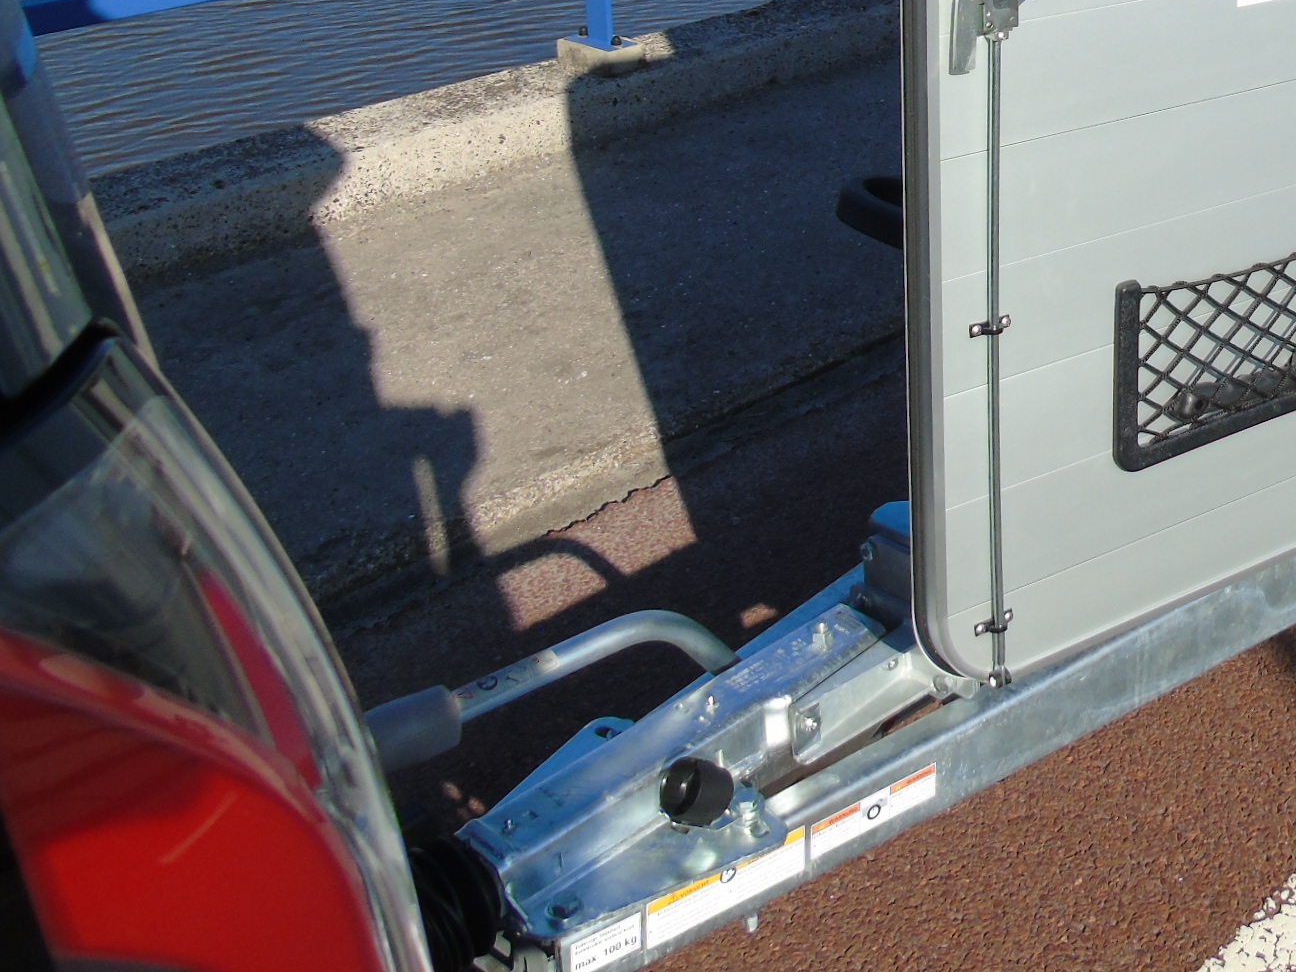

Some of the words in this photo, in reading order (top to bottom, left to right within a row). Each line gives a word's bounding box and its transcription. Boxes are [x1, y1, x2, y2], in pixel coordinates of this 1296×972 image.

[575, 955, 600, 971] max.
[603, 941, 622, 956] 100
[624, 935, 637, 946] kg
